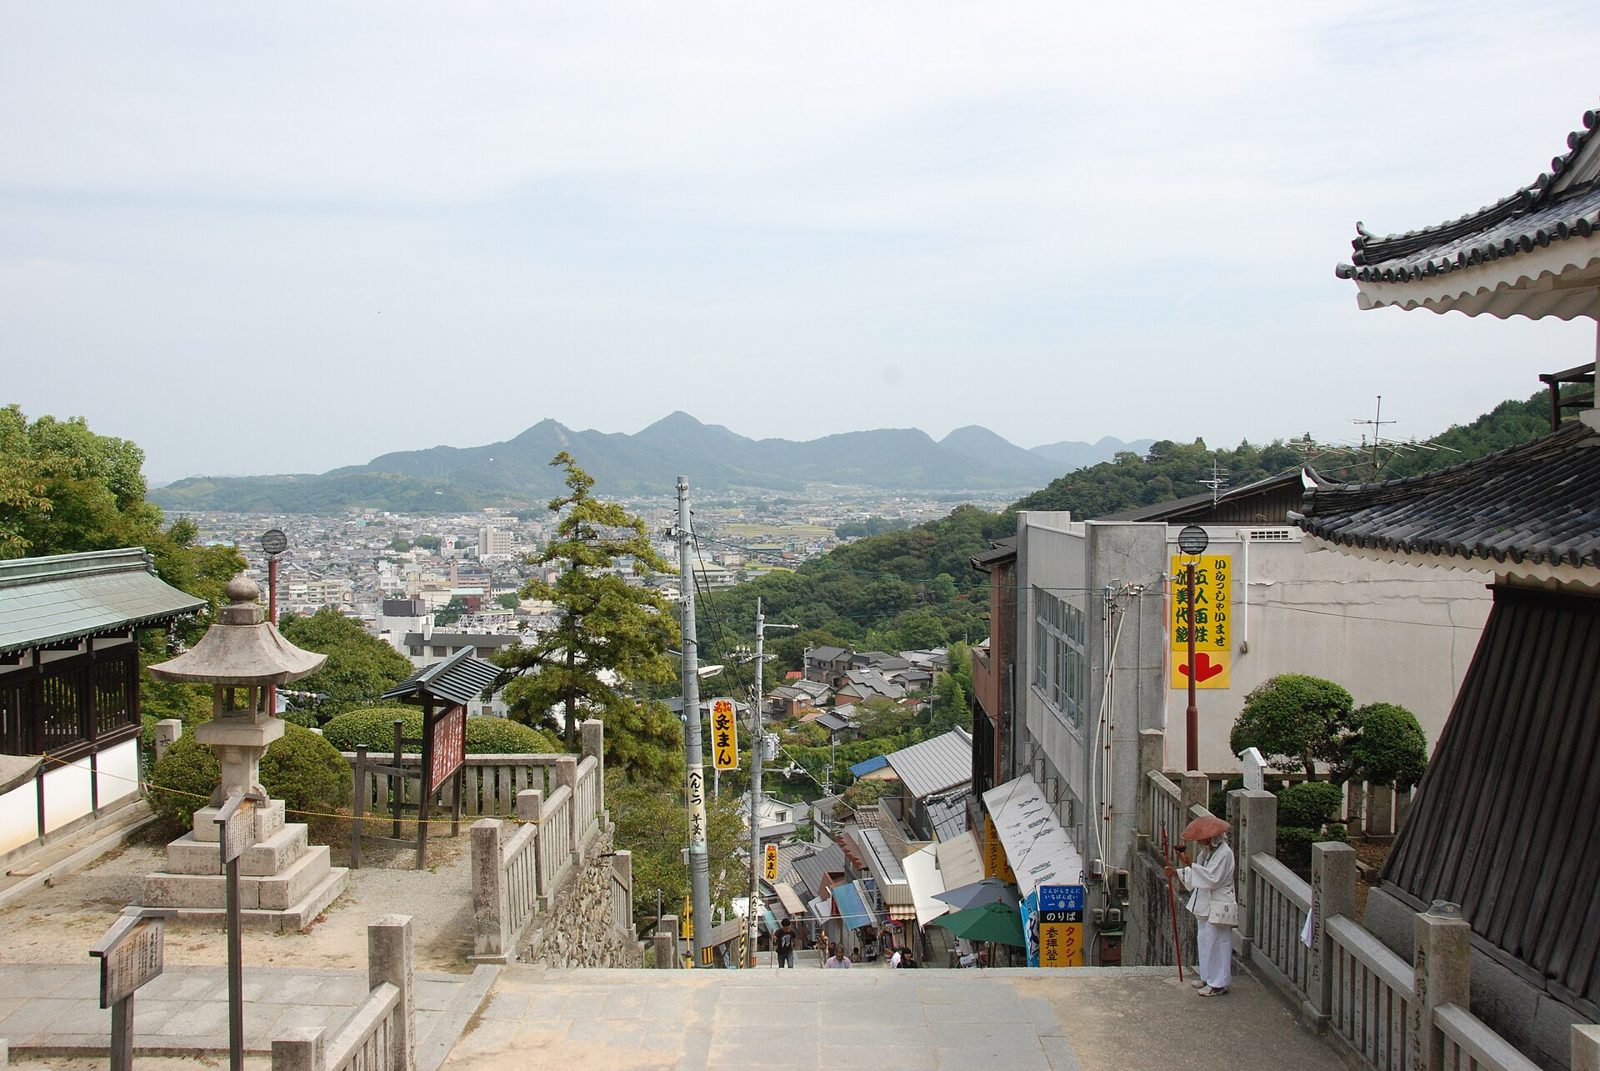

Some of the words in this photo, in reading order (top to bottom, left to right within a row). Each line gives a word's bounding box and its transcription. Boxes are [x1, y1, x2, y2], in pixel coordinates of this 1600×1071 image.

[1214, 559, 1227, 647] いらっしゃいませ
[714, 713, 732, 766] 灸まん
[689, 771, 703, 806] へんこつ
[1046, 911, 1076, 921] のりば
[1065, 926, 1075, 967] タクシー
